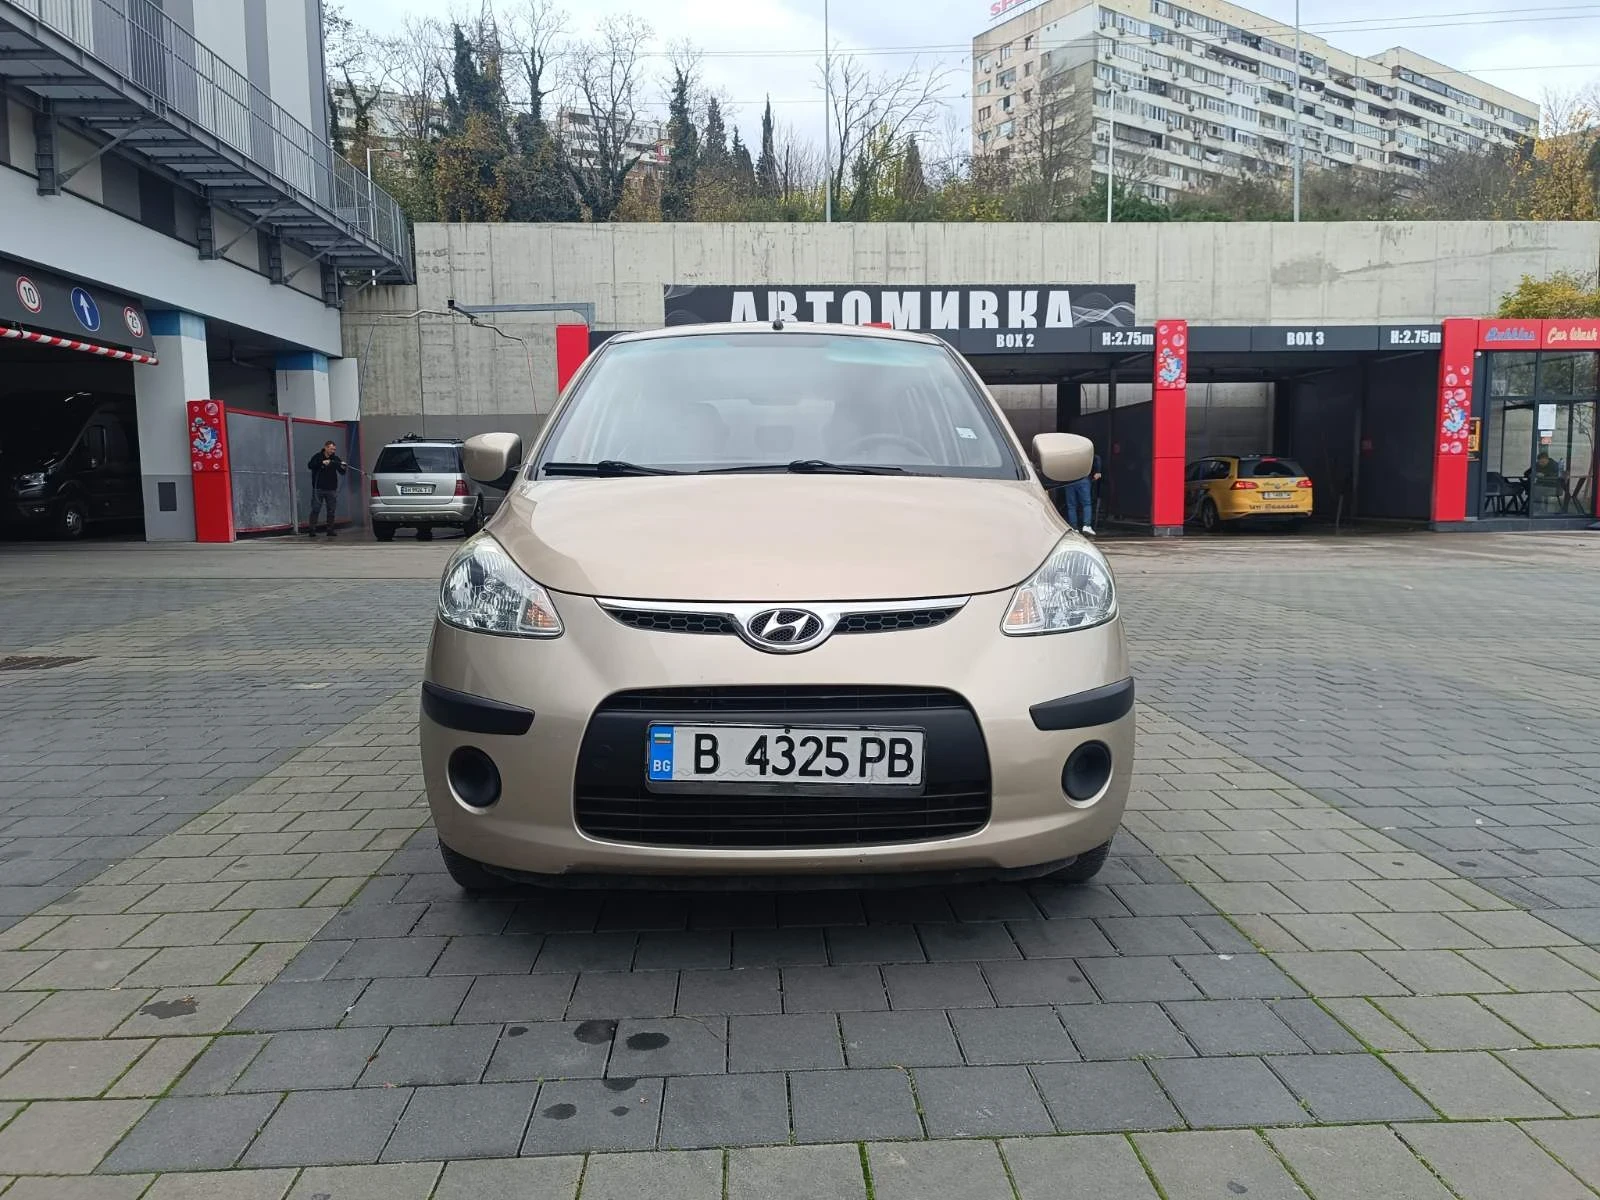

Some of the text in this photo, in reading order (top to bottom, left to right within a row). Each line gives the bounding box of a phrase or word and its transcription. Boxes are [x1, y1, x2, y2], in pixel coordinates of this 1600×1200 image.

[23, 286, 37, 305] 10
[730, 290, 1073, 330] АВТОМИВКА
[996, 333, 1035, 348] BOX 2
[1101, 331, 1154, 346] H:2.75m
[1286, 331, 1325, 346] BOX 3
[1390, 329, 1442, 344] H:2.75m
[1547, 326, 1598, 344] Car Wash
[693, 733, 915, 778] B 4325 PB
[652, 759, 671, 773] BG
